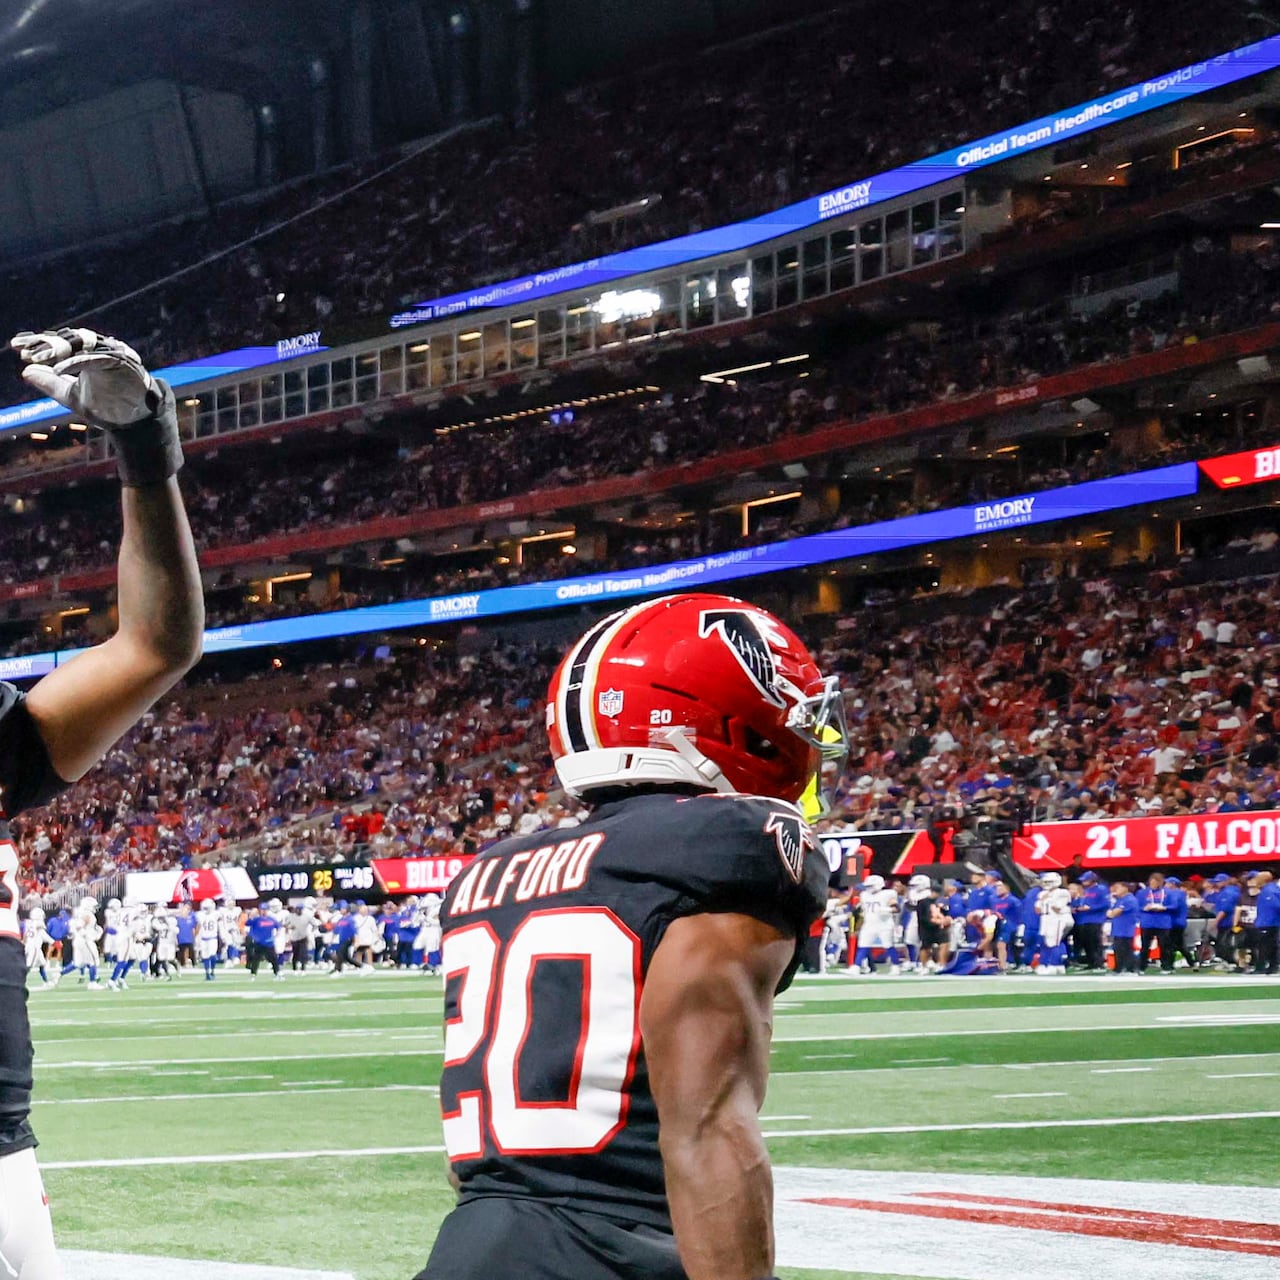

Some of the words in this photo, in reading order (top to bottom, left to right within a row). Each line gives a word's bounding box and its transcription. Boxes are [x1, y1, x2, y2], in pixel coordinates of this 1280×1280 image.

[955, 138, 1007, 167] Official
[1010, 125, 1051, 149] Team
[1053, 90, 1139, 134] Healthcare
[1142, 58, 1209, 97] Provider
[819, 181, 871, 211] EMORY
[390, 307, 433, 327] Official
[434, 299, 467, 318] Team
[468, 280, 533, 306] Healthcare
[534, 262, 585, 287] Provider
[278, 331, 321, 353] EMORY
[21, 400, 60, 419] Healthca
[975, 497, 1035, 524] EMORY
[976, 514, 1032, 530] HEALTHCARE
[557, 582, 603, 600] Official
[605, 577, 641, 595] Team
[644, 562, 705, 587] Healthcare
[707, 550, 753, 571] Provider
[430, 595, 479, 614] EMORY
[0, 658, 33, 672] EMORY
[650, 709, 672, 724] 20
[1086, 825, 1131, 858] 21
[1156, 818, 1280, 858] FALCO
[258, 873, 280, 891] 1ST
[293, 872, 309, 889] 10
[313, 870, 333, 890] 25
[406, 859, 463, 889] BILLS
[448, 832, 607, 917] ALFORD
[441, 905, 643, 1163] 20
